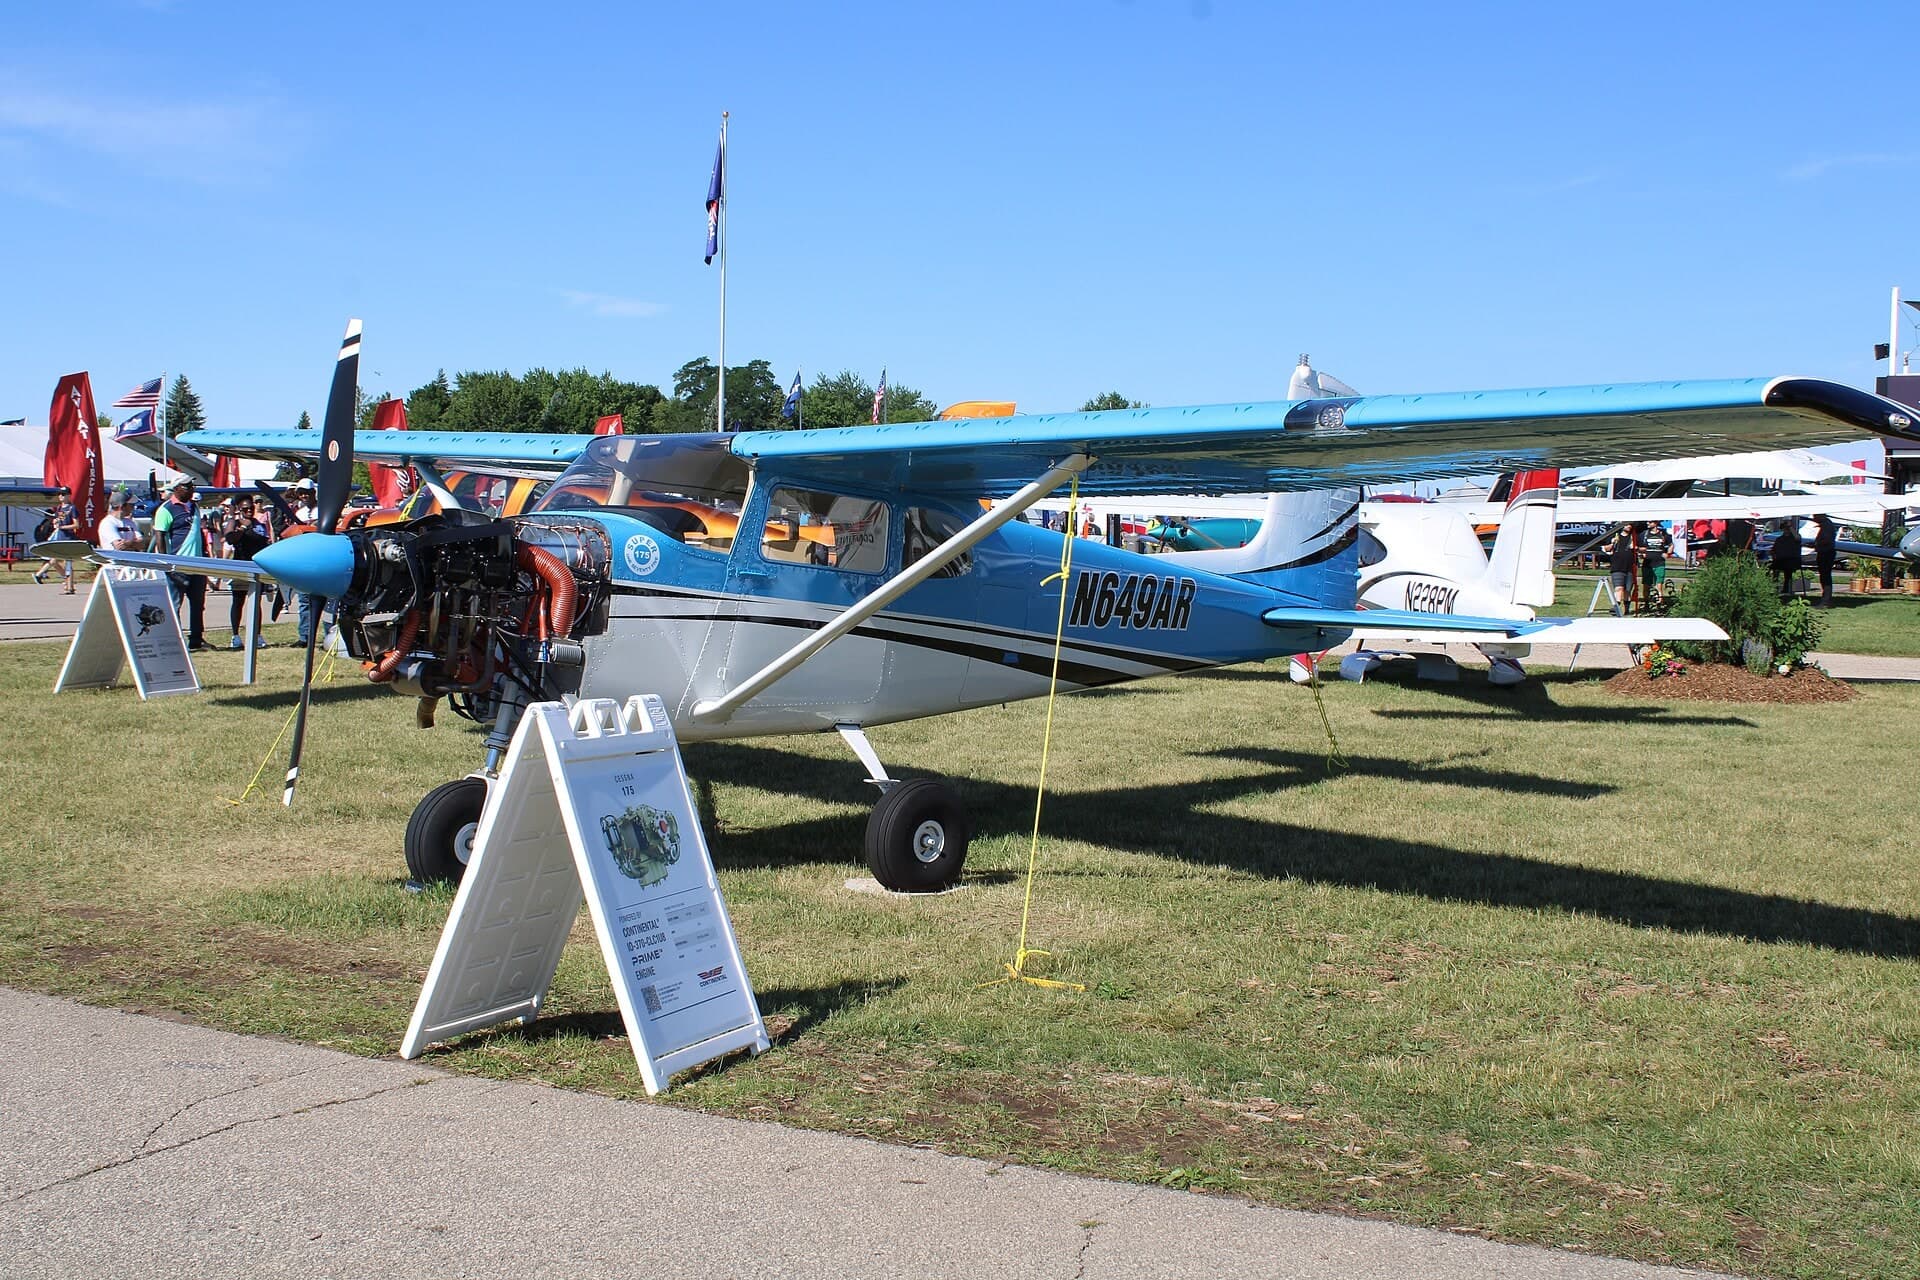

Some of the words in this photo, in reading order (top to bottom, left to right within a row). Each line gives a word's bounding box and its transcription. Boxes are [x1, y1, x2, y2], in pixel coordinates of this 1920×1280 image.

[71, 385, 89, 440] AVIAT
[85, 447, 96, 528] AIRCRAFT
[627, 536, 658, 553] SUPER
[634, 550, 650, 559] 175
[1067, 570, 1197, 631] N649AR
[1405, 580, 1460, 615] N228PM
[622, 785, 635, 796] 175
[635, 966, 656, 981] ENGINE
